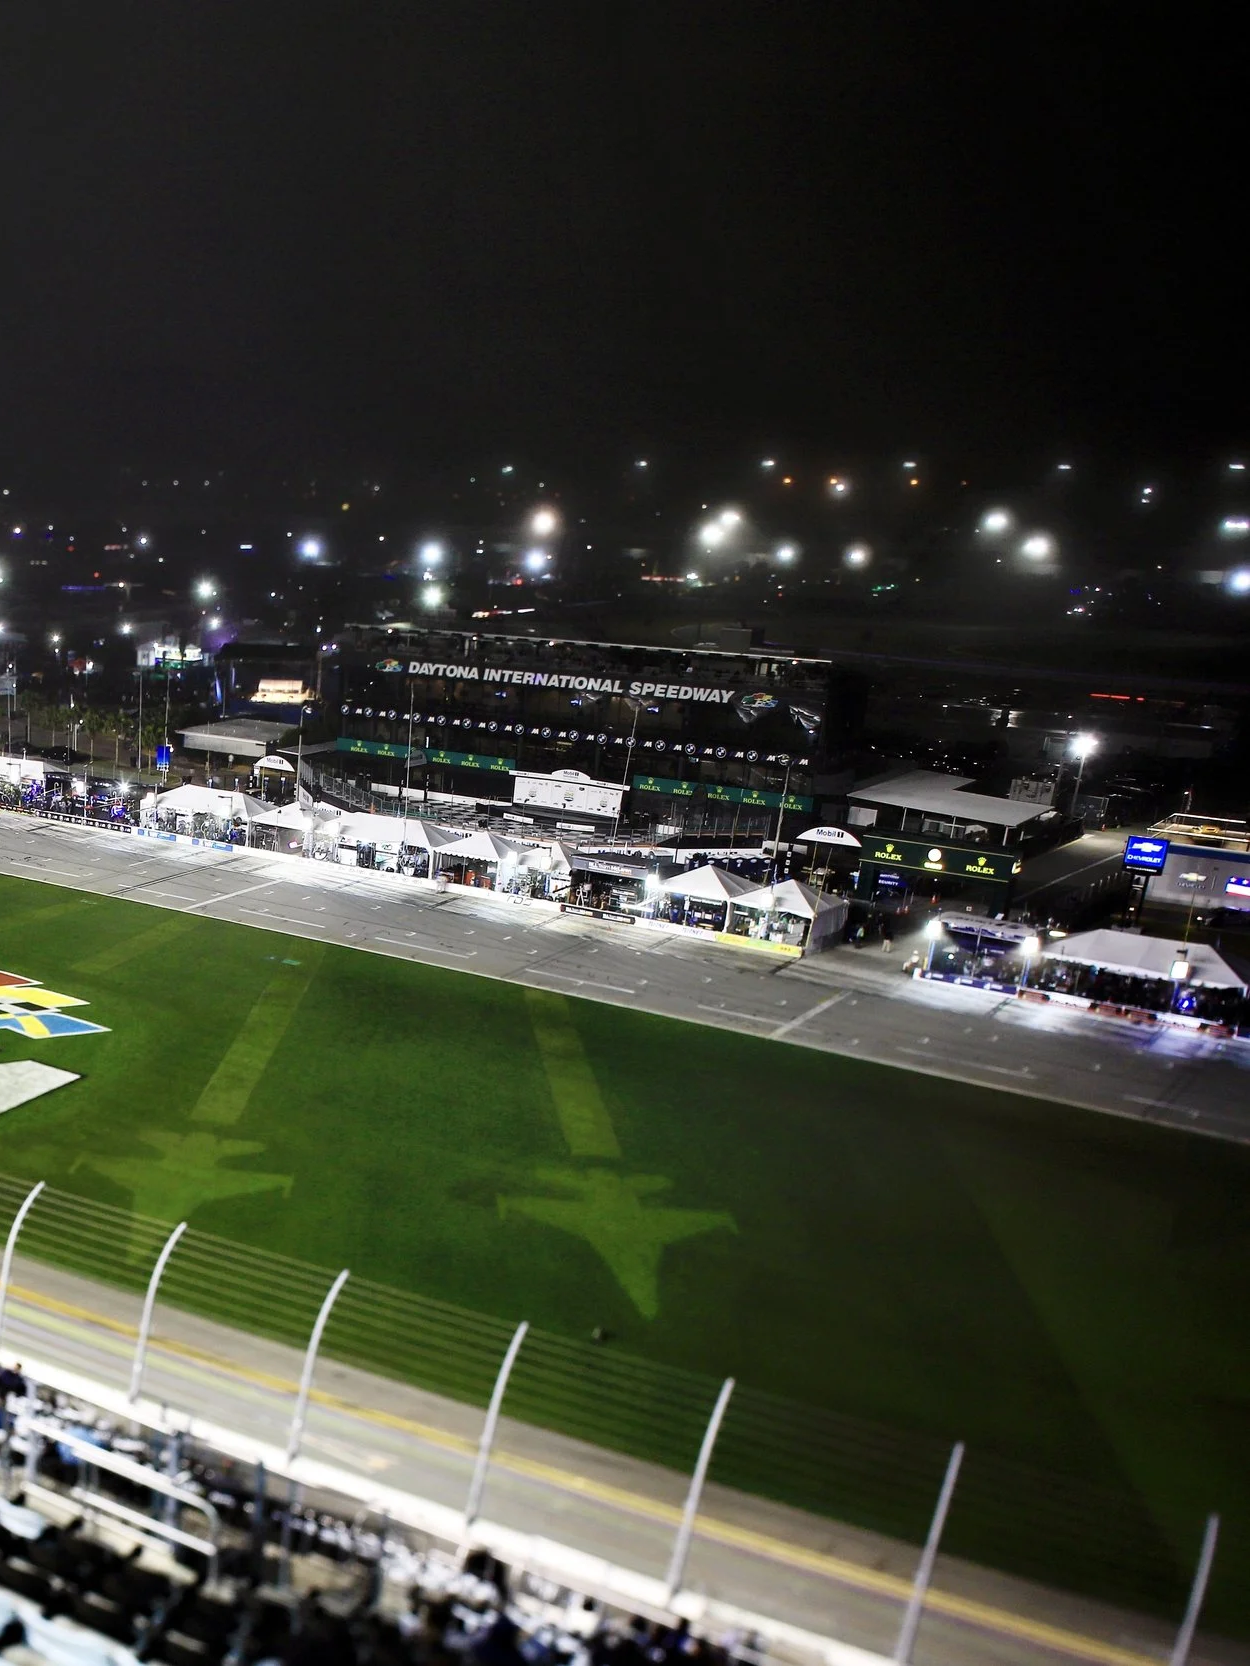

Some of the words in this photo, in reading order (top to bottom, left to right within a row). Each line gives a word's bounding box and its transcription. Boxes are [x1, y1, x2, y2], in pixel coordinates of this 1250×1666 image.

[408, 661, 479, 681] DAYTONA
[482, 668, 623, 695] INTERNATIONAL
[628, 681, 736, 704] SPEEDWAY
[350, 746, 368, 754] ROLEX
[461, 760, 480, 768] ROLEX
[490, 763, 510, 771] ROLEX
[639, 783, 661, 792] ROLEX
[707, 792, 730, 801] ROLEX
[742, 797, 766, 806] ROLEX
[816, 828, 837, 838] Mobil
[874, 851, 902, 861] ROLEX
[1127, 854, 1162, 863] CHEVROLET
[965, 864, 995, 875] ROLEX
